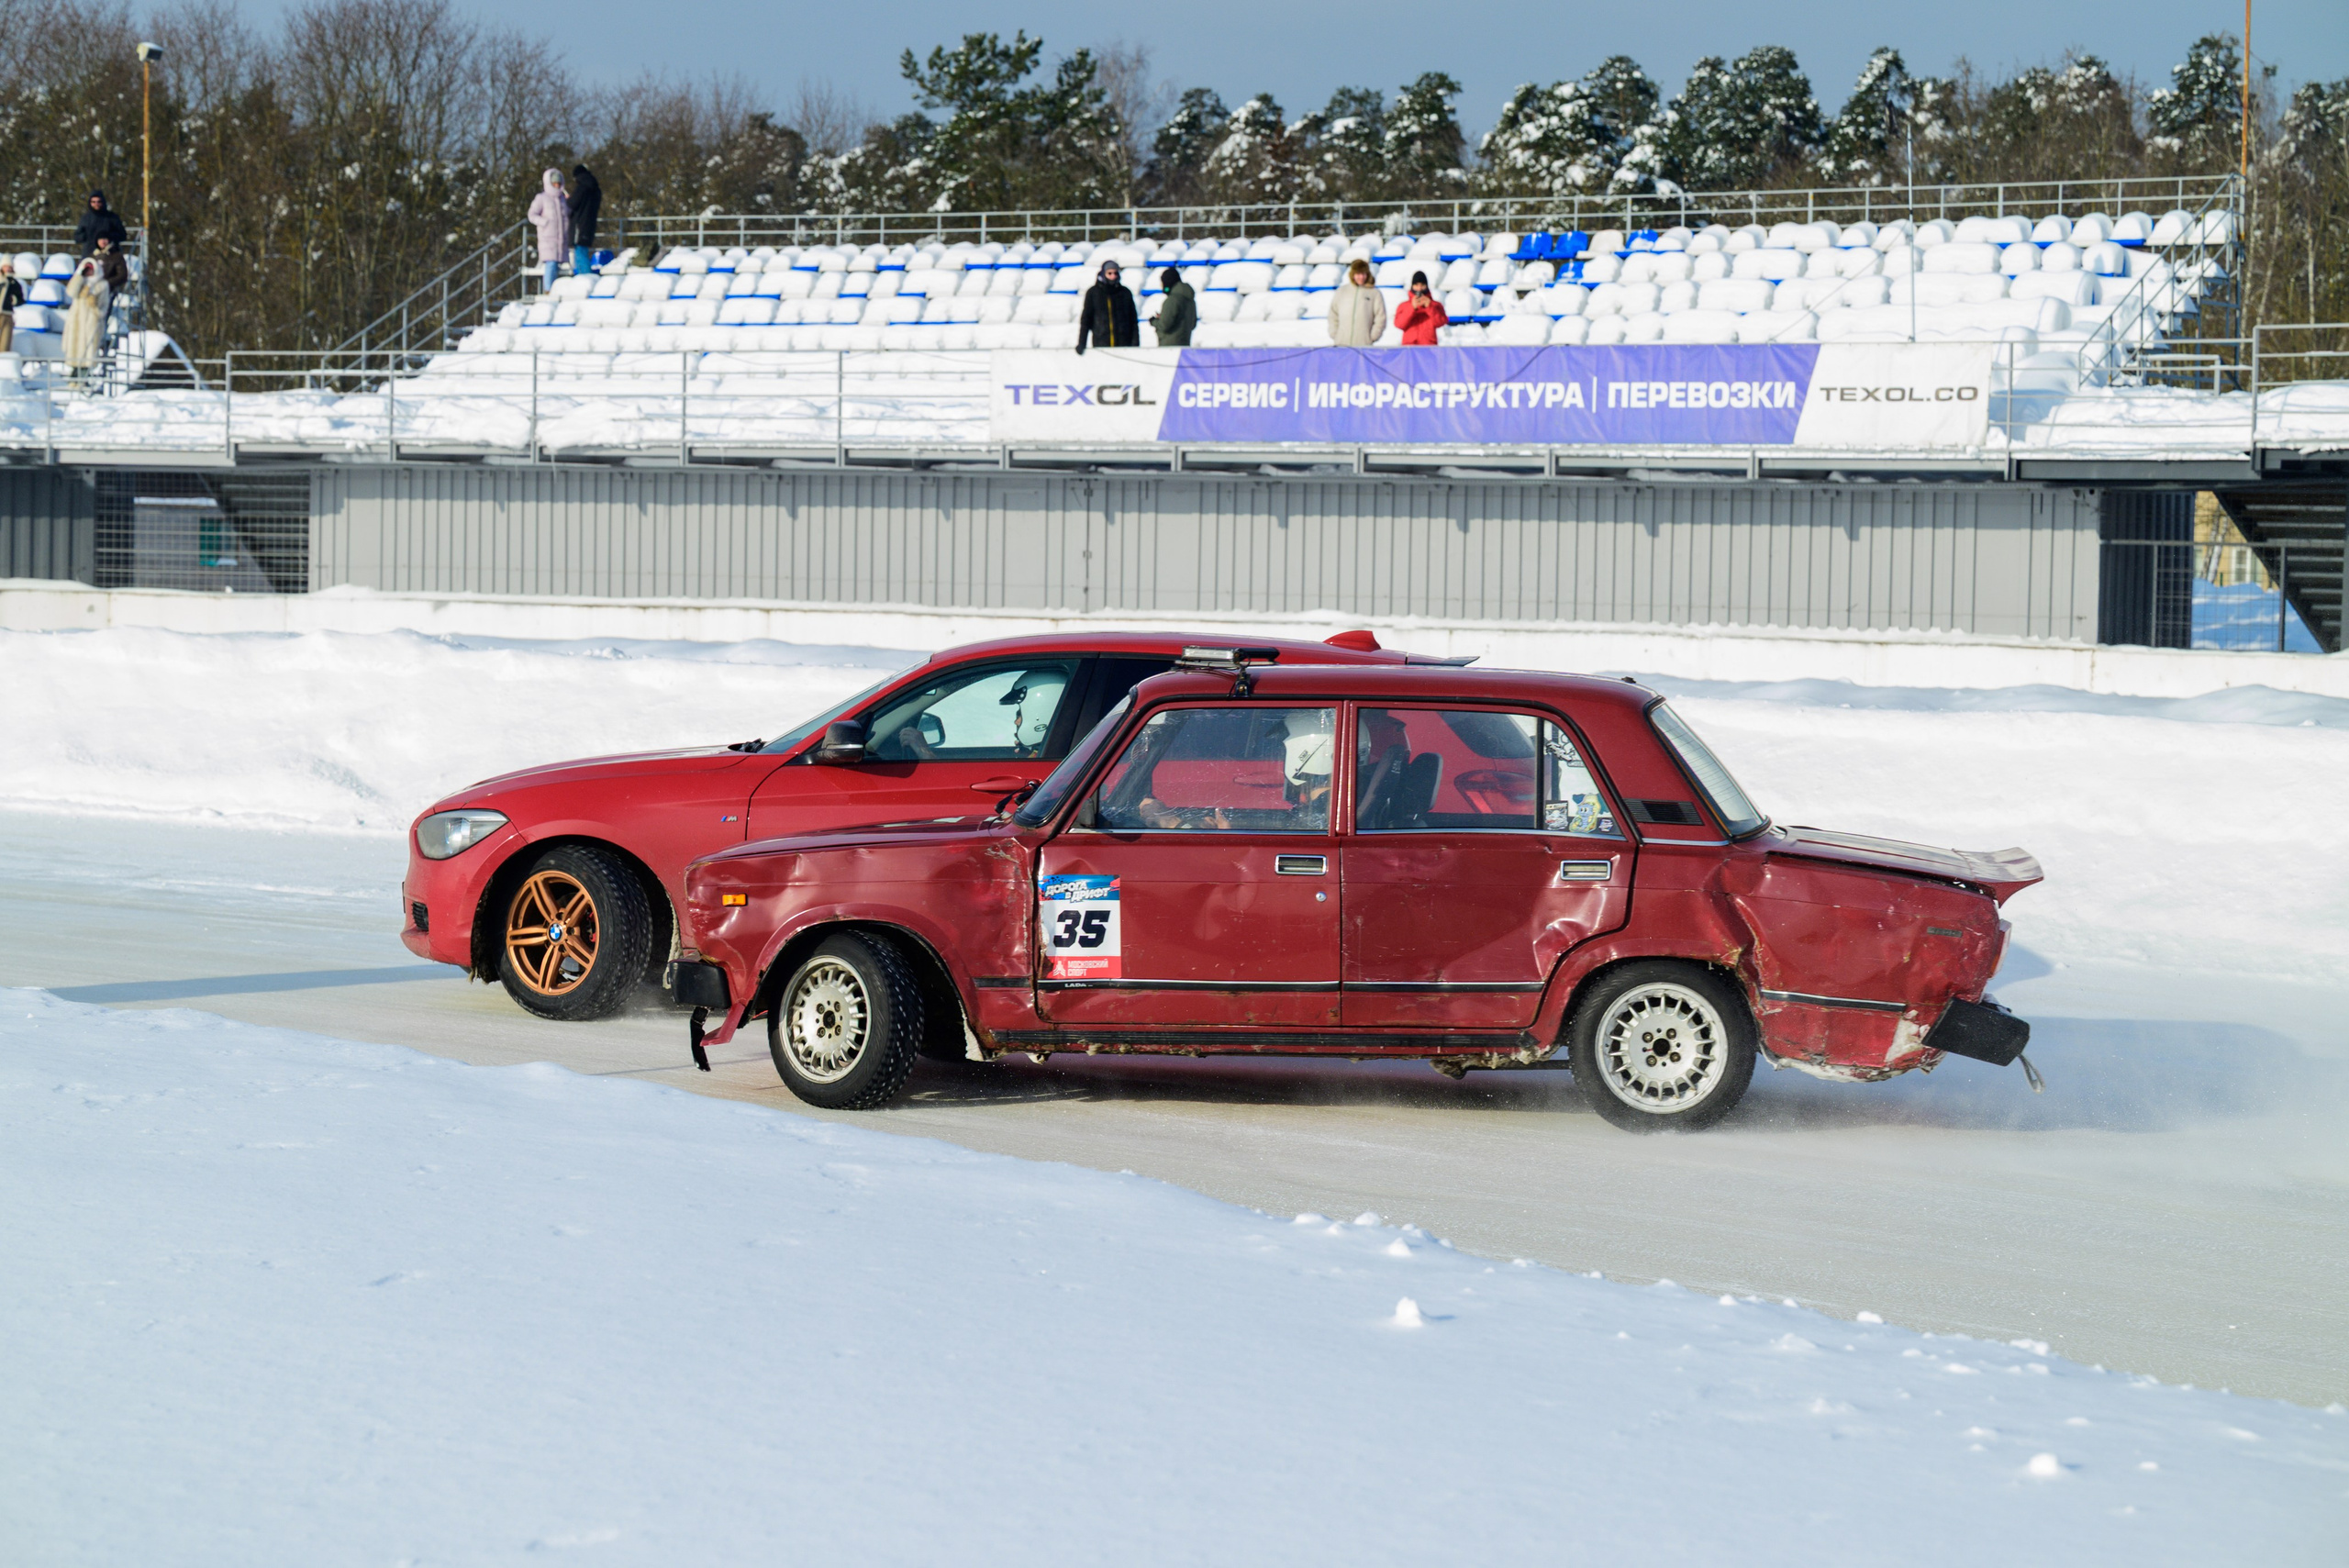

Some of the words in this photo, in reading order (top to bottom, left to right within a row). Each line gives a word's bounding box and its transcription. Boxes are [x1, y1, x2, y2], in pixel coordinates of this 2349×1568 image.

[1005, 384, 1156, 406] TEXOL
[1178, 382, 1288, 408] СЕРВИС
[1308, 382, 1585, 409] ИНФРАСТРУКТУРА
[1608, 381, 1796, 409] ПЕРЕВОЗКИ
[1820, 386, 1978, 402] TEXOL.CO
[1045, 880, 1088, 897] ДОРОГА
[1070, 887, 1111, 903] ДРИФТ
[1053, 910, 1111, 948] 35
